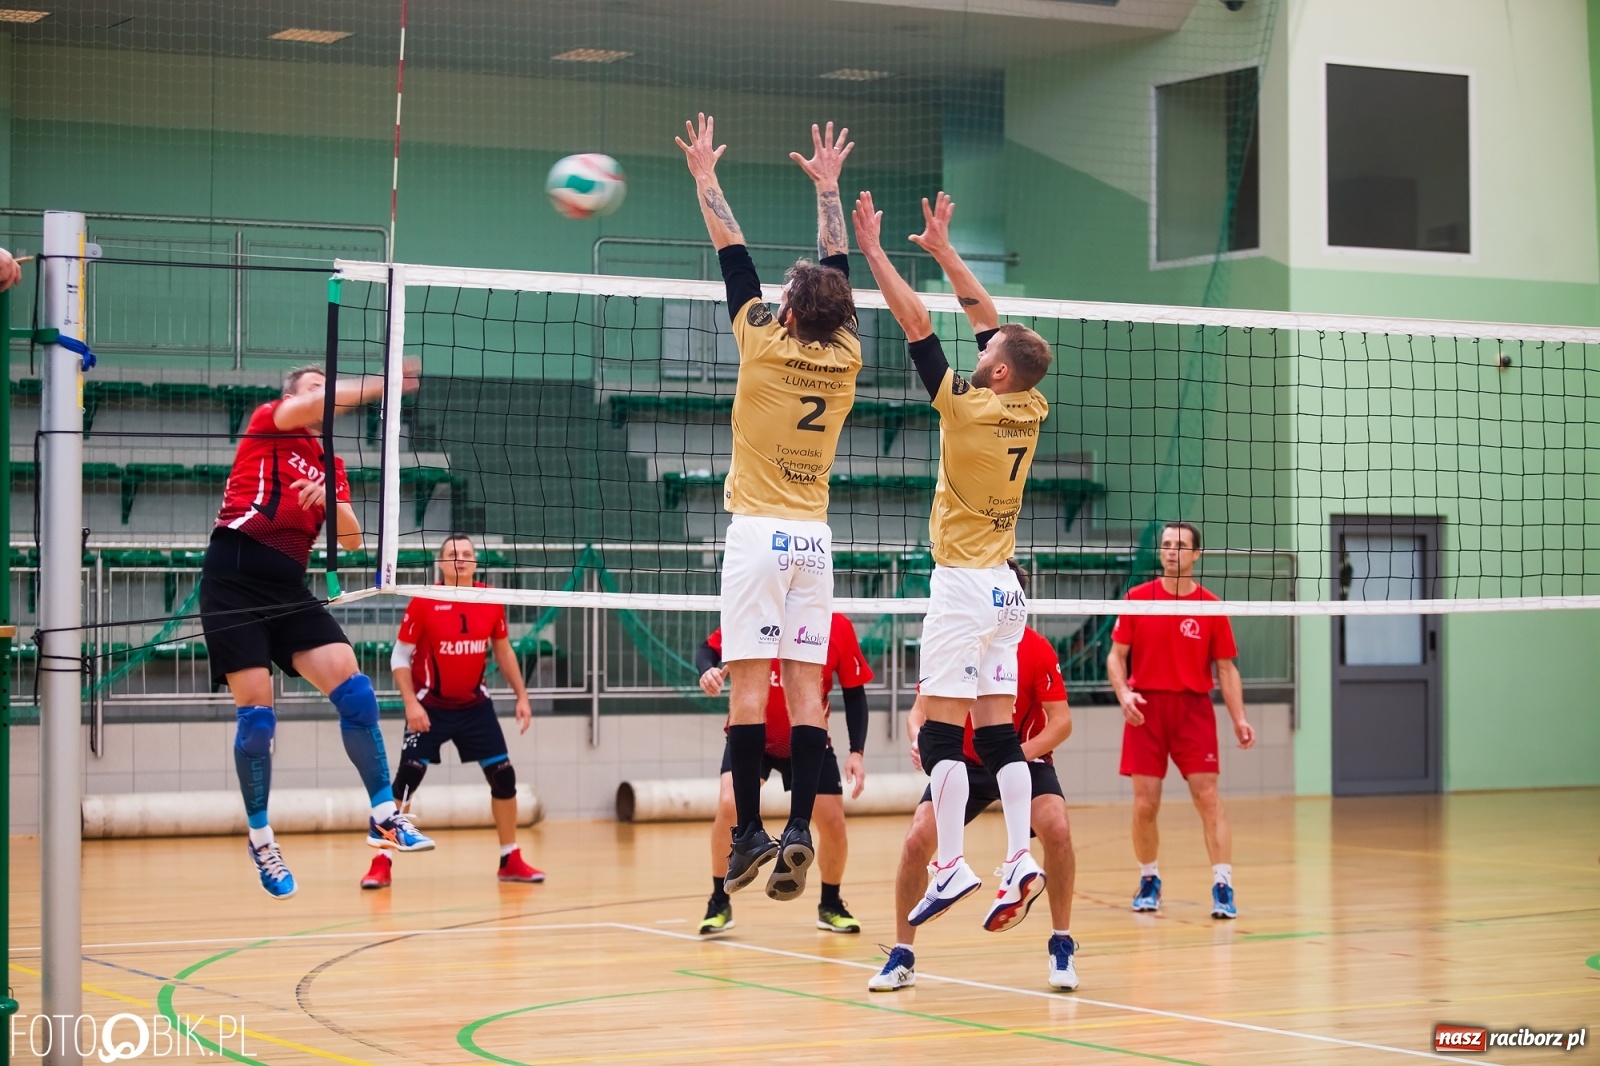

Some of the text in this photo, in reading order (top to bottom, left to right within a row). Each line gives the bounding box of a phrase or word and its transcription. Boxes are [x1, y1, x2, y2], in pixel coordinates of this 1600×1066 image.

[797, 395, 827, 432] 2
[775, 443, 823, 459] Towalski
[1007, 446, 1028, 482] 7
[793, 535, 826, 554] DK
[777, 549, 826, 571] glass
[460, 613, 469, 634] 1
